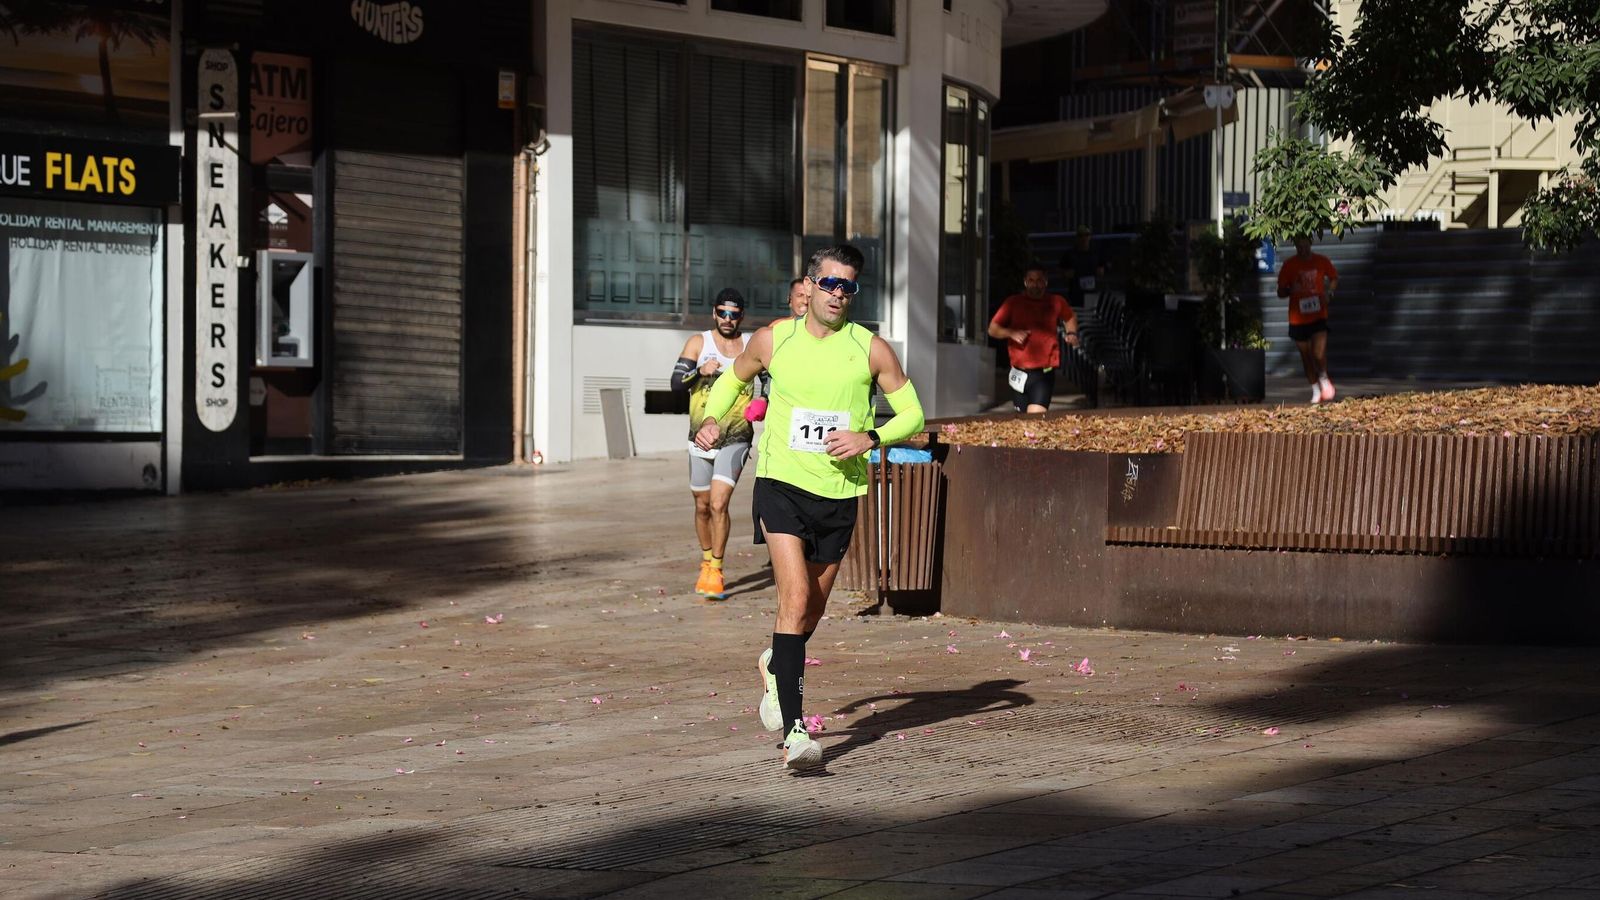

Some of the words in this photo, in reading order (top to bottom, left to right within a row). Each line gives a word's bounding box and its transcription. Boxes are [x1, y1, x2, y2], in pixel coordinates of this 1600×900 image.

[351, 0, 424, 44] HUNTERS
[205, 60, 229, 72] SHOP
[248, 62, 307, 101] ATM
[0, 154, 31, 187] UE
[46, 152, 136, 195] FLATS
[44, 217, 86, 232] RENTAL
[87, 219, 159, 236] MANAGEMENT
[208, 83, 227, 389] SNEAKERS
[205, 398, 229, 408] SHOP
